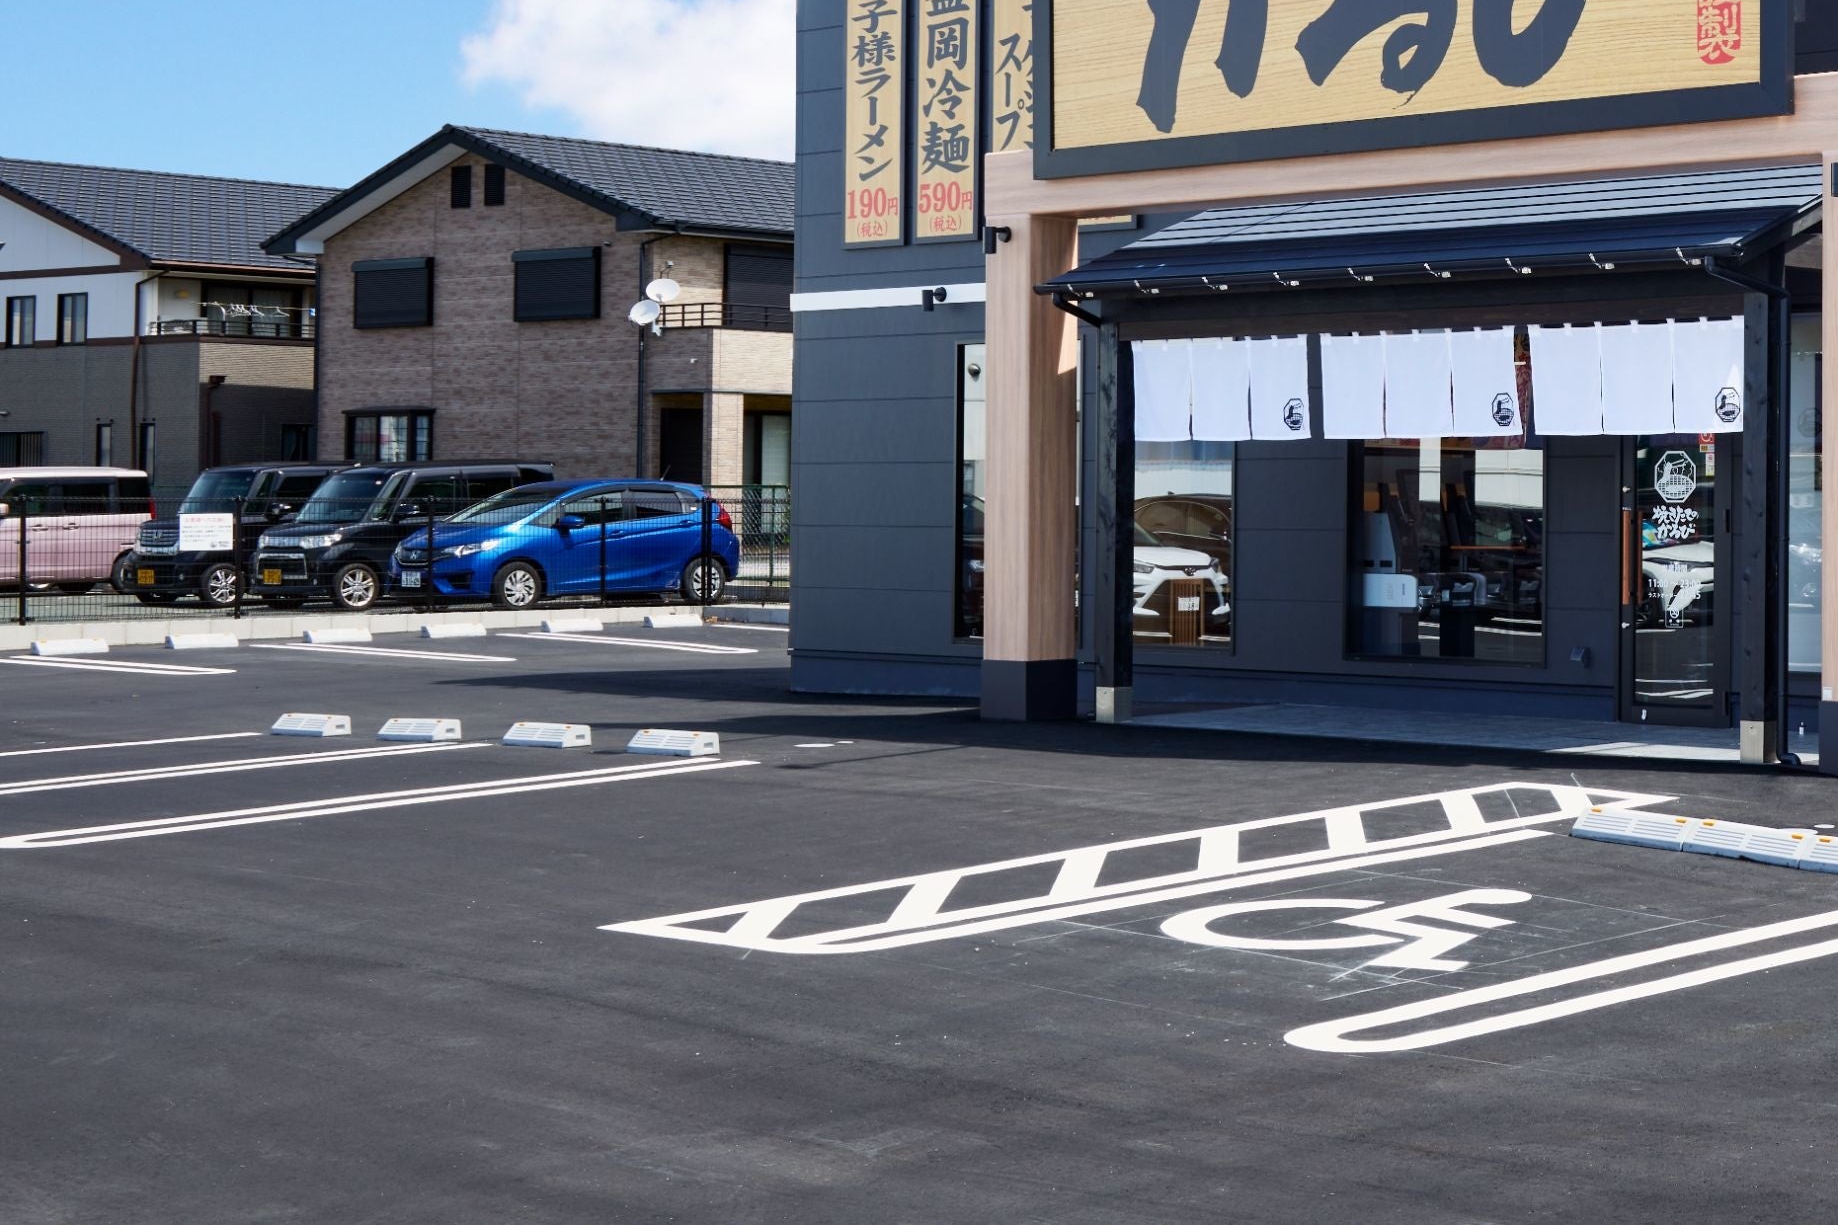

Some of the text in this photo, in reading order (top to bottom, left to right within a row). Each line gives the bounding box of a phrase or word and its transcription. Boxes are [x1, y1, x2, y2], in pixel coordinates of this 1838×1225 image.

[995, 32, 1025, 152] スープ
[847, 187, 899, 220] 190円
[918, 181, 974, 214] 590円
